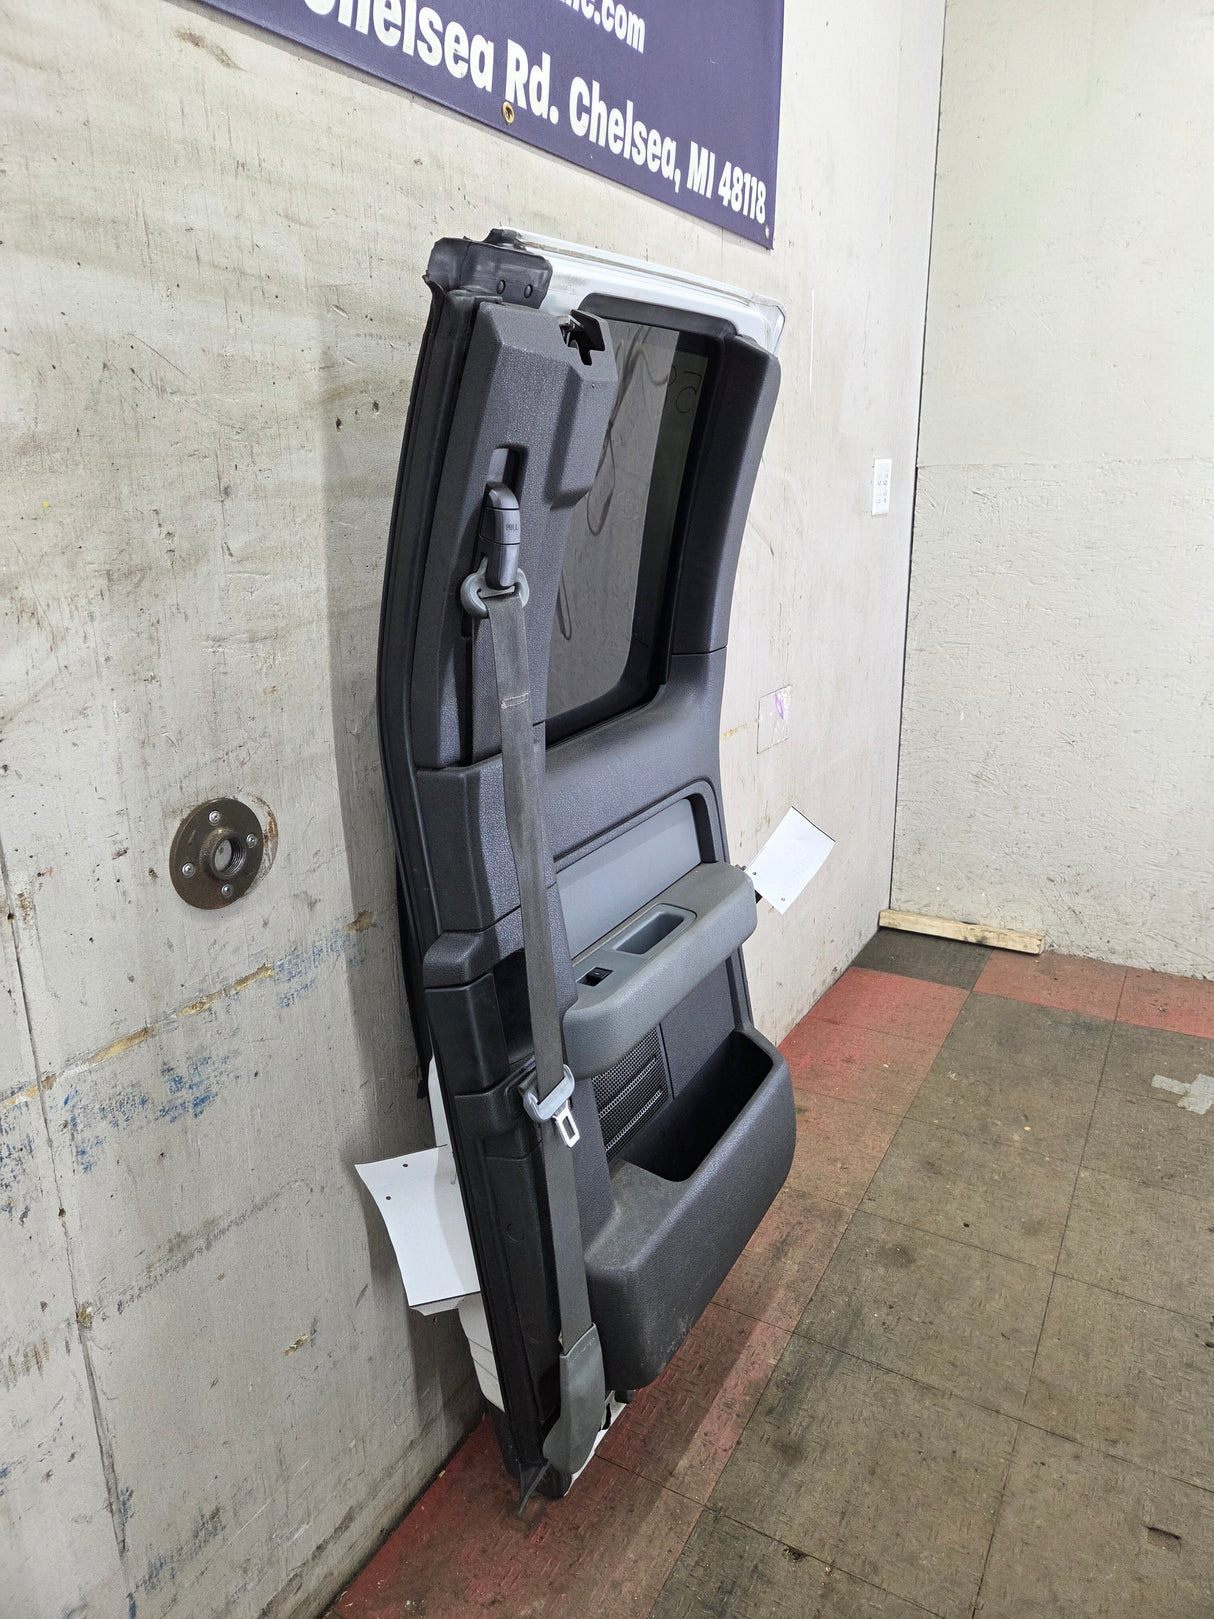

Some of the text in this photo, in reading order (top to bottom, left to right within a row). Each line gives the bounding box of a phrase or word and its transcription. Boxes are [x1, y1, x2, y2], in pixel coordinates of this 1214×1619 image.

[304, 0, 767, 224] elsea Rd. Chelsea, MI 48118
[505, 523, 519, 531] PULL
